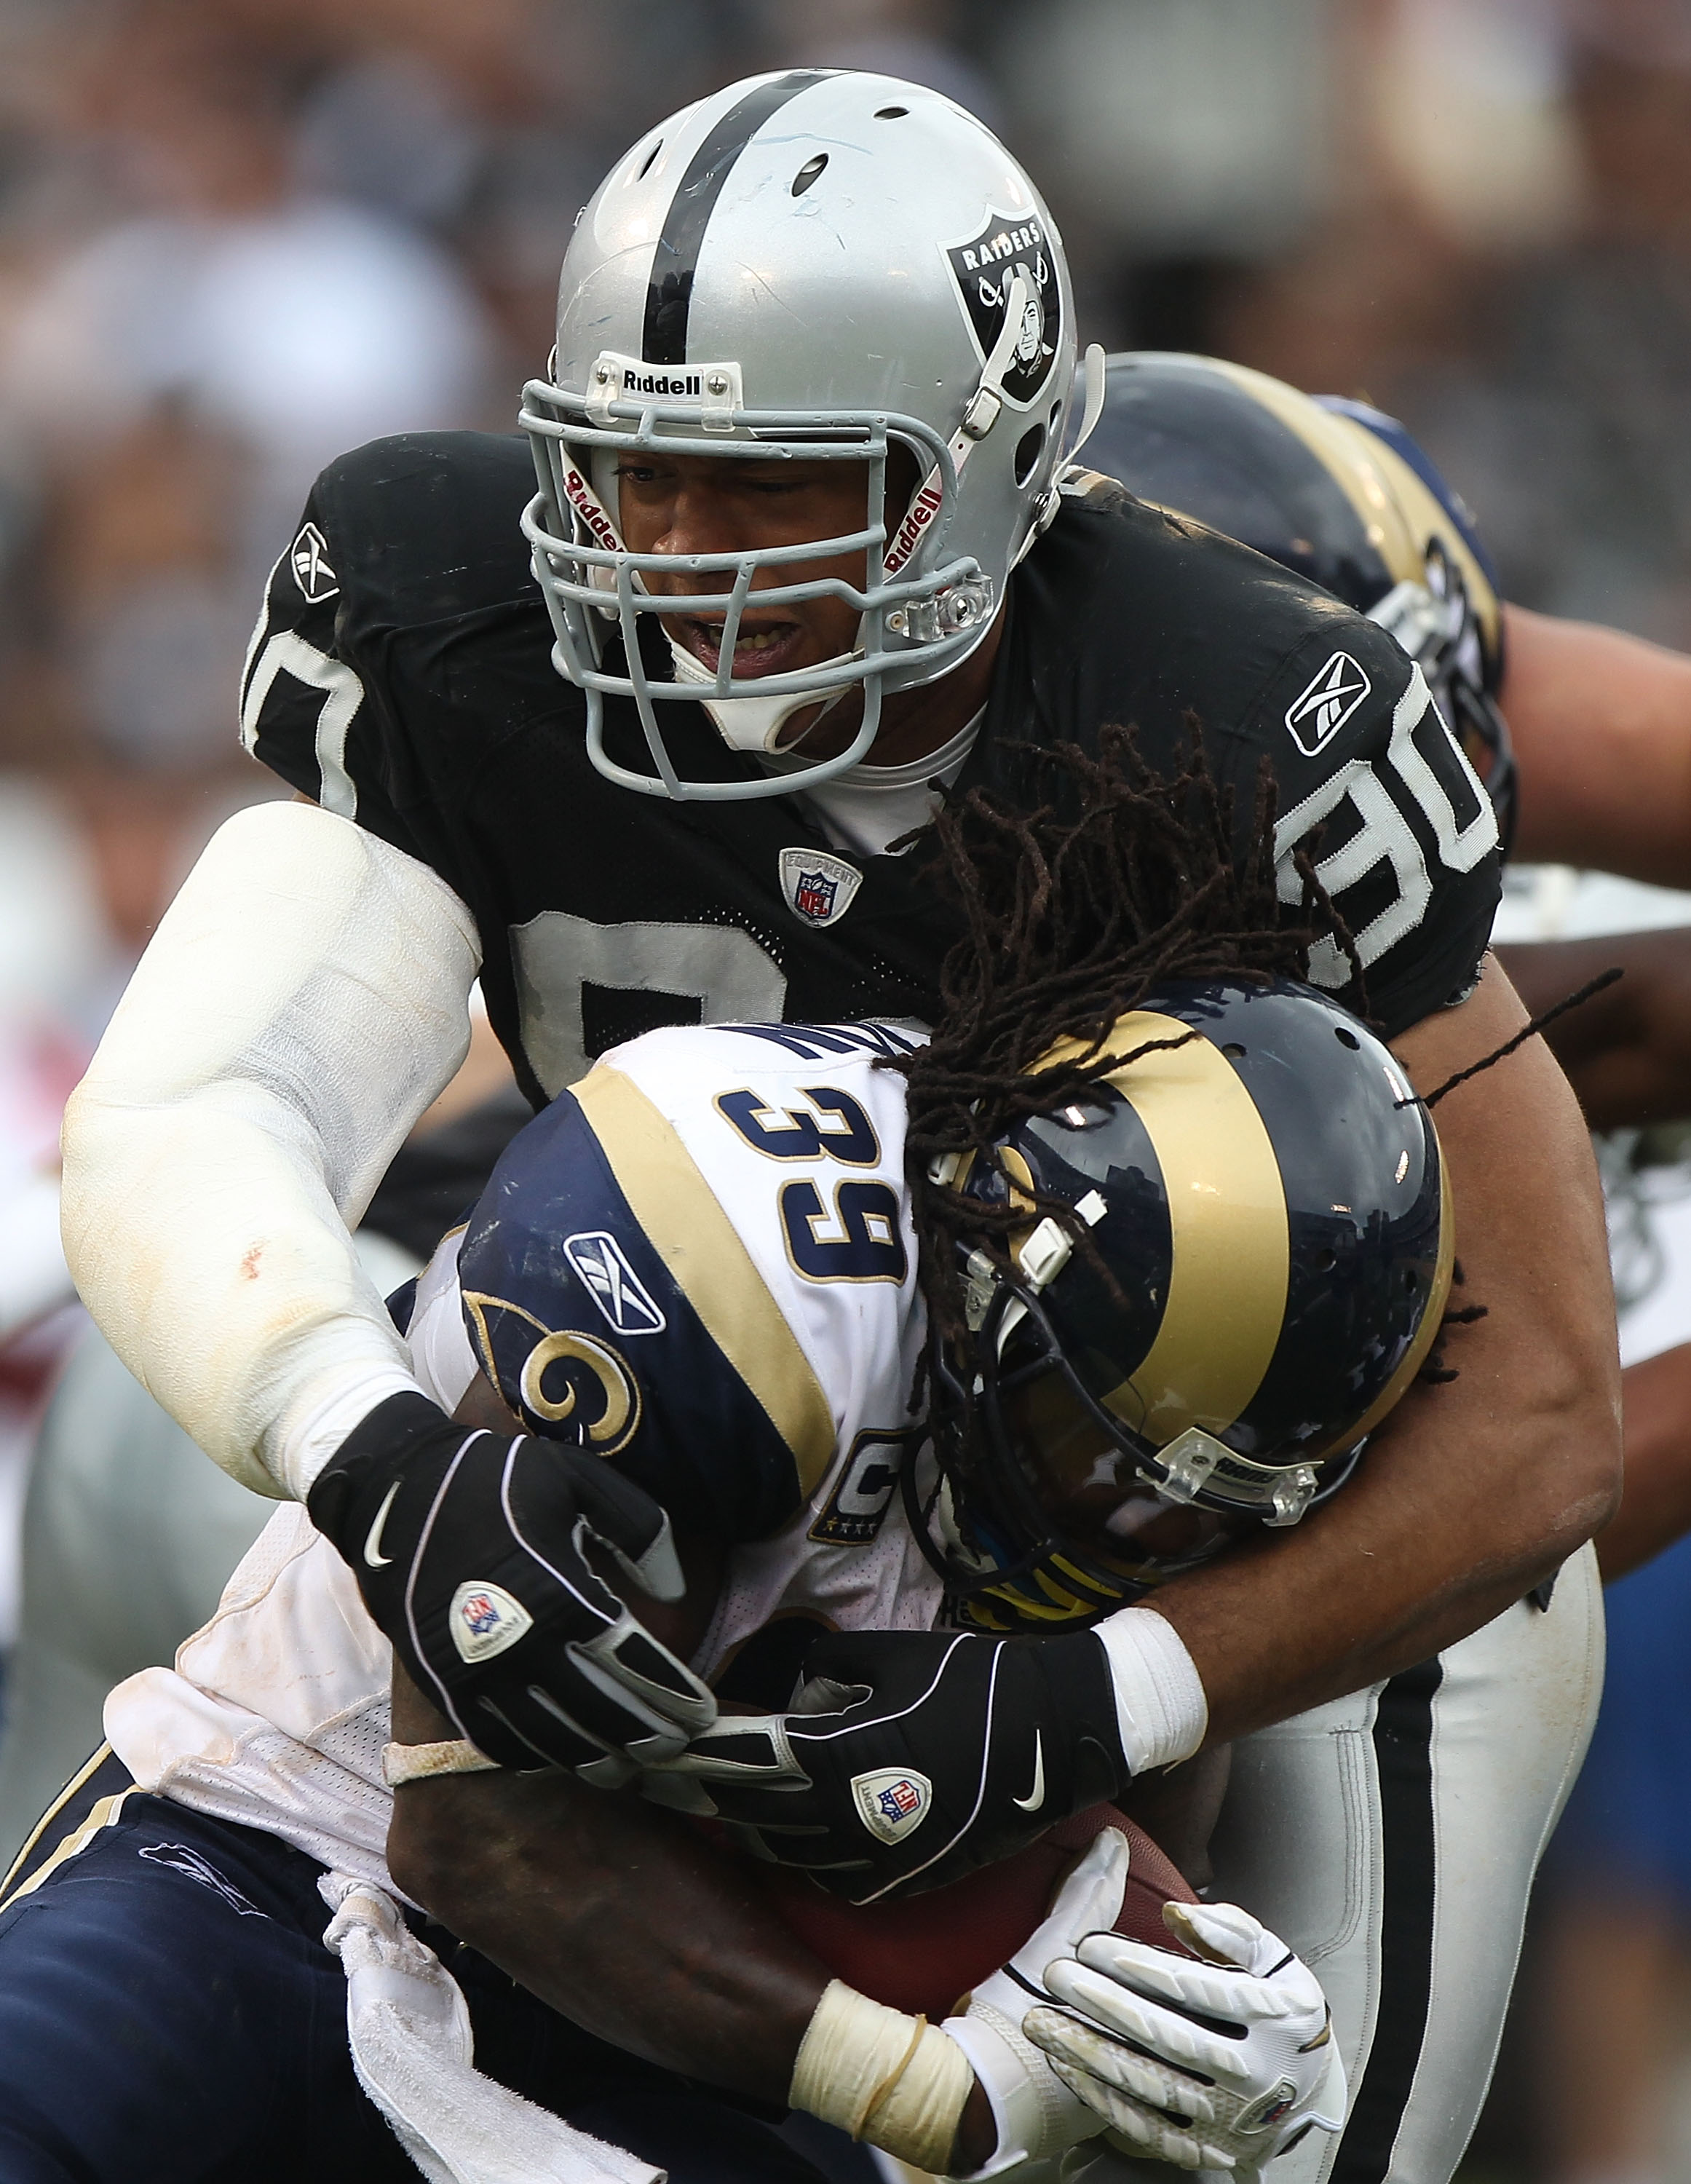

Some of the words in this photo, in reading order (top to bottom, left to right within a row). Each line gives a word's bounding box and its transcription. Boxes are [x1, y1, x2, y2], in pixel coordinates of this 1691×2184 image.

[962, 222, 1039, 270] RAIDERS
[623, 369, 700, 395] Riddell
[884, 487, 942, 573] Riddell
[712, 1086, 908, 1288] 39
[838, 1443, 904, 1515] C
[892, 1781, 918, 1814] NFL
